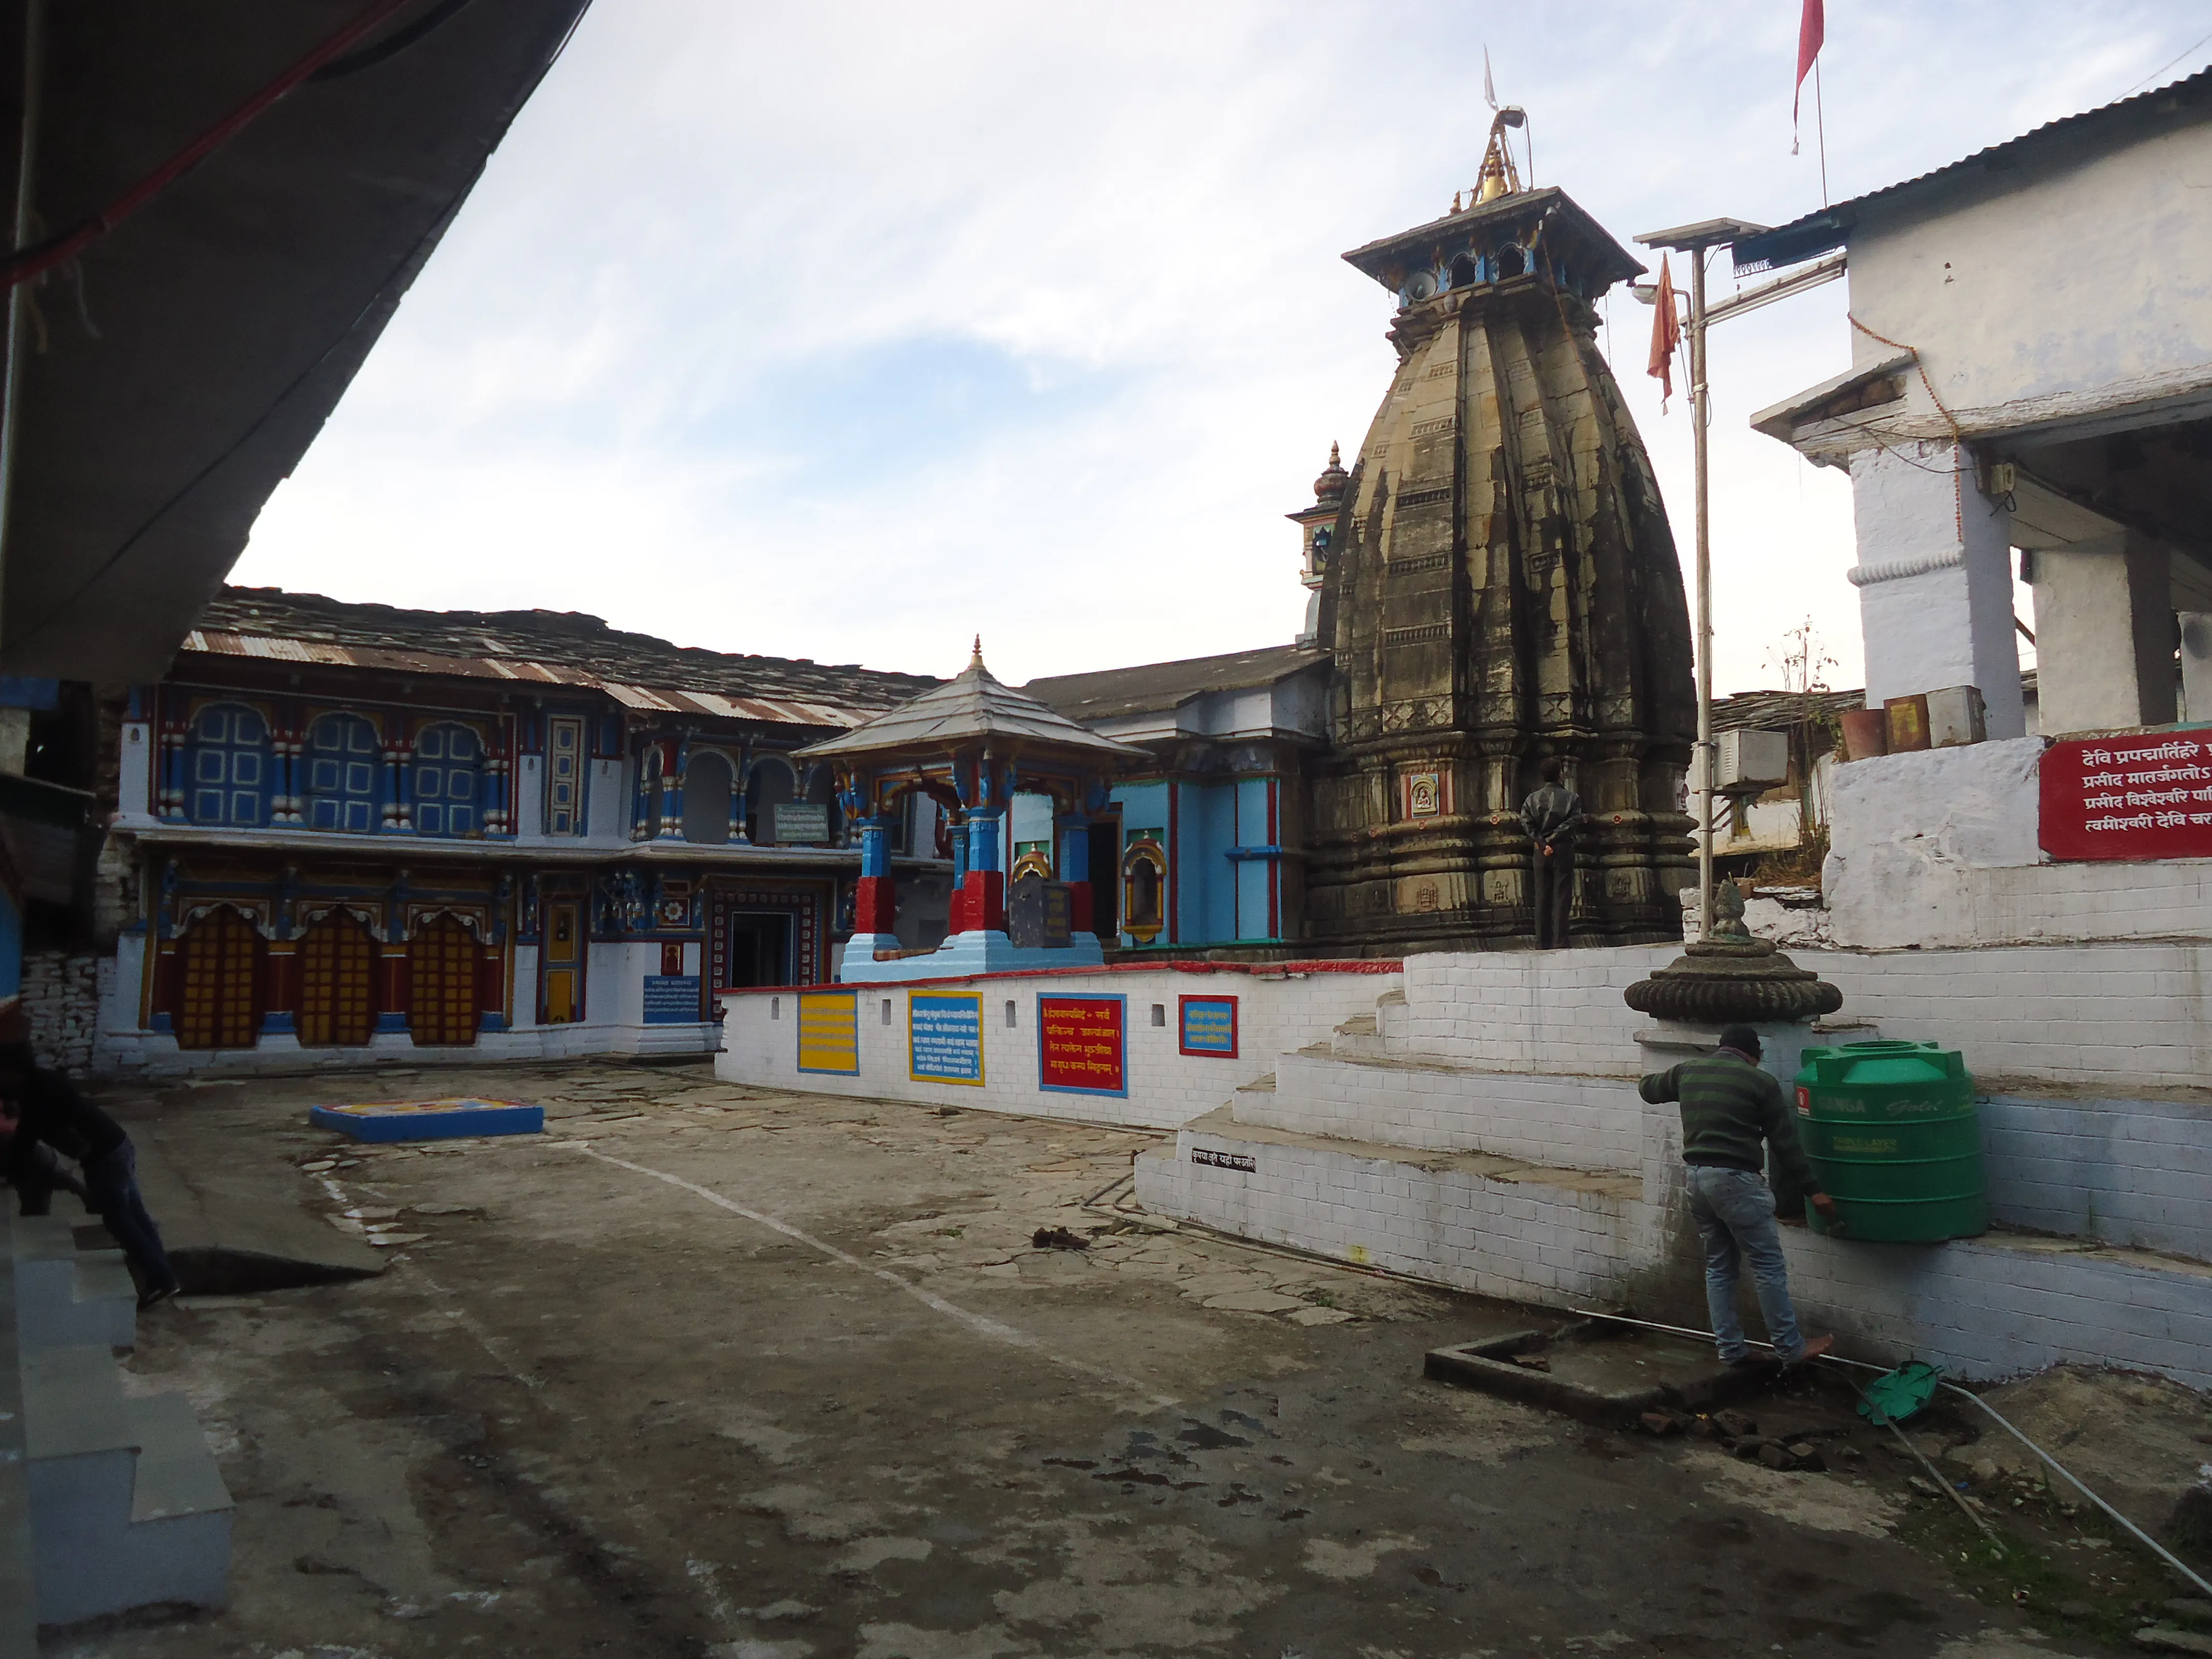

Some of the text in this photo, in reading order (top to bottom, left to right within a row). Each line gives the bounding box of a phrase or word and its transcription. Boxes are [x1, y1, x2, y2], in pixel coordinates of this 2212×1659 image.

[2082, 750, 2111, 767] देवि
[2081, 763, 2212, 788] प्रसीद मातर्जगतोऽ
[2083, 792, 2124, 809] प्रसीद
[2155, 811, 2186, 828] देवि
